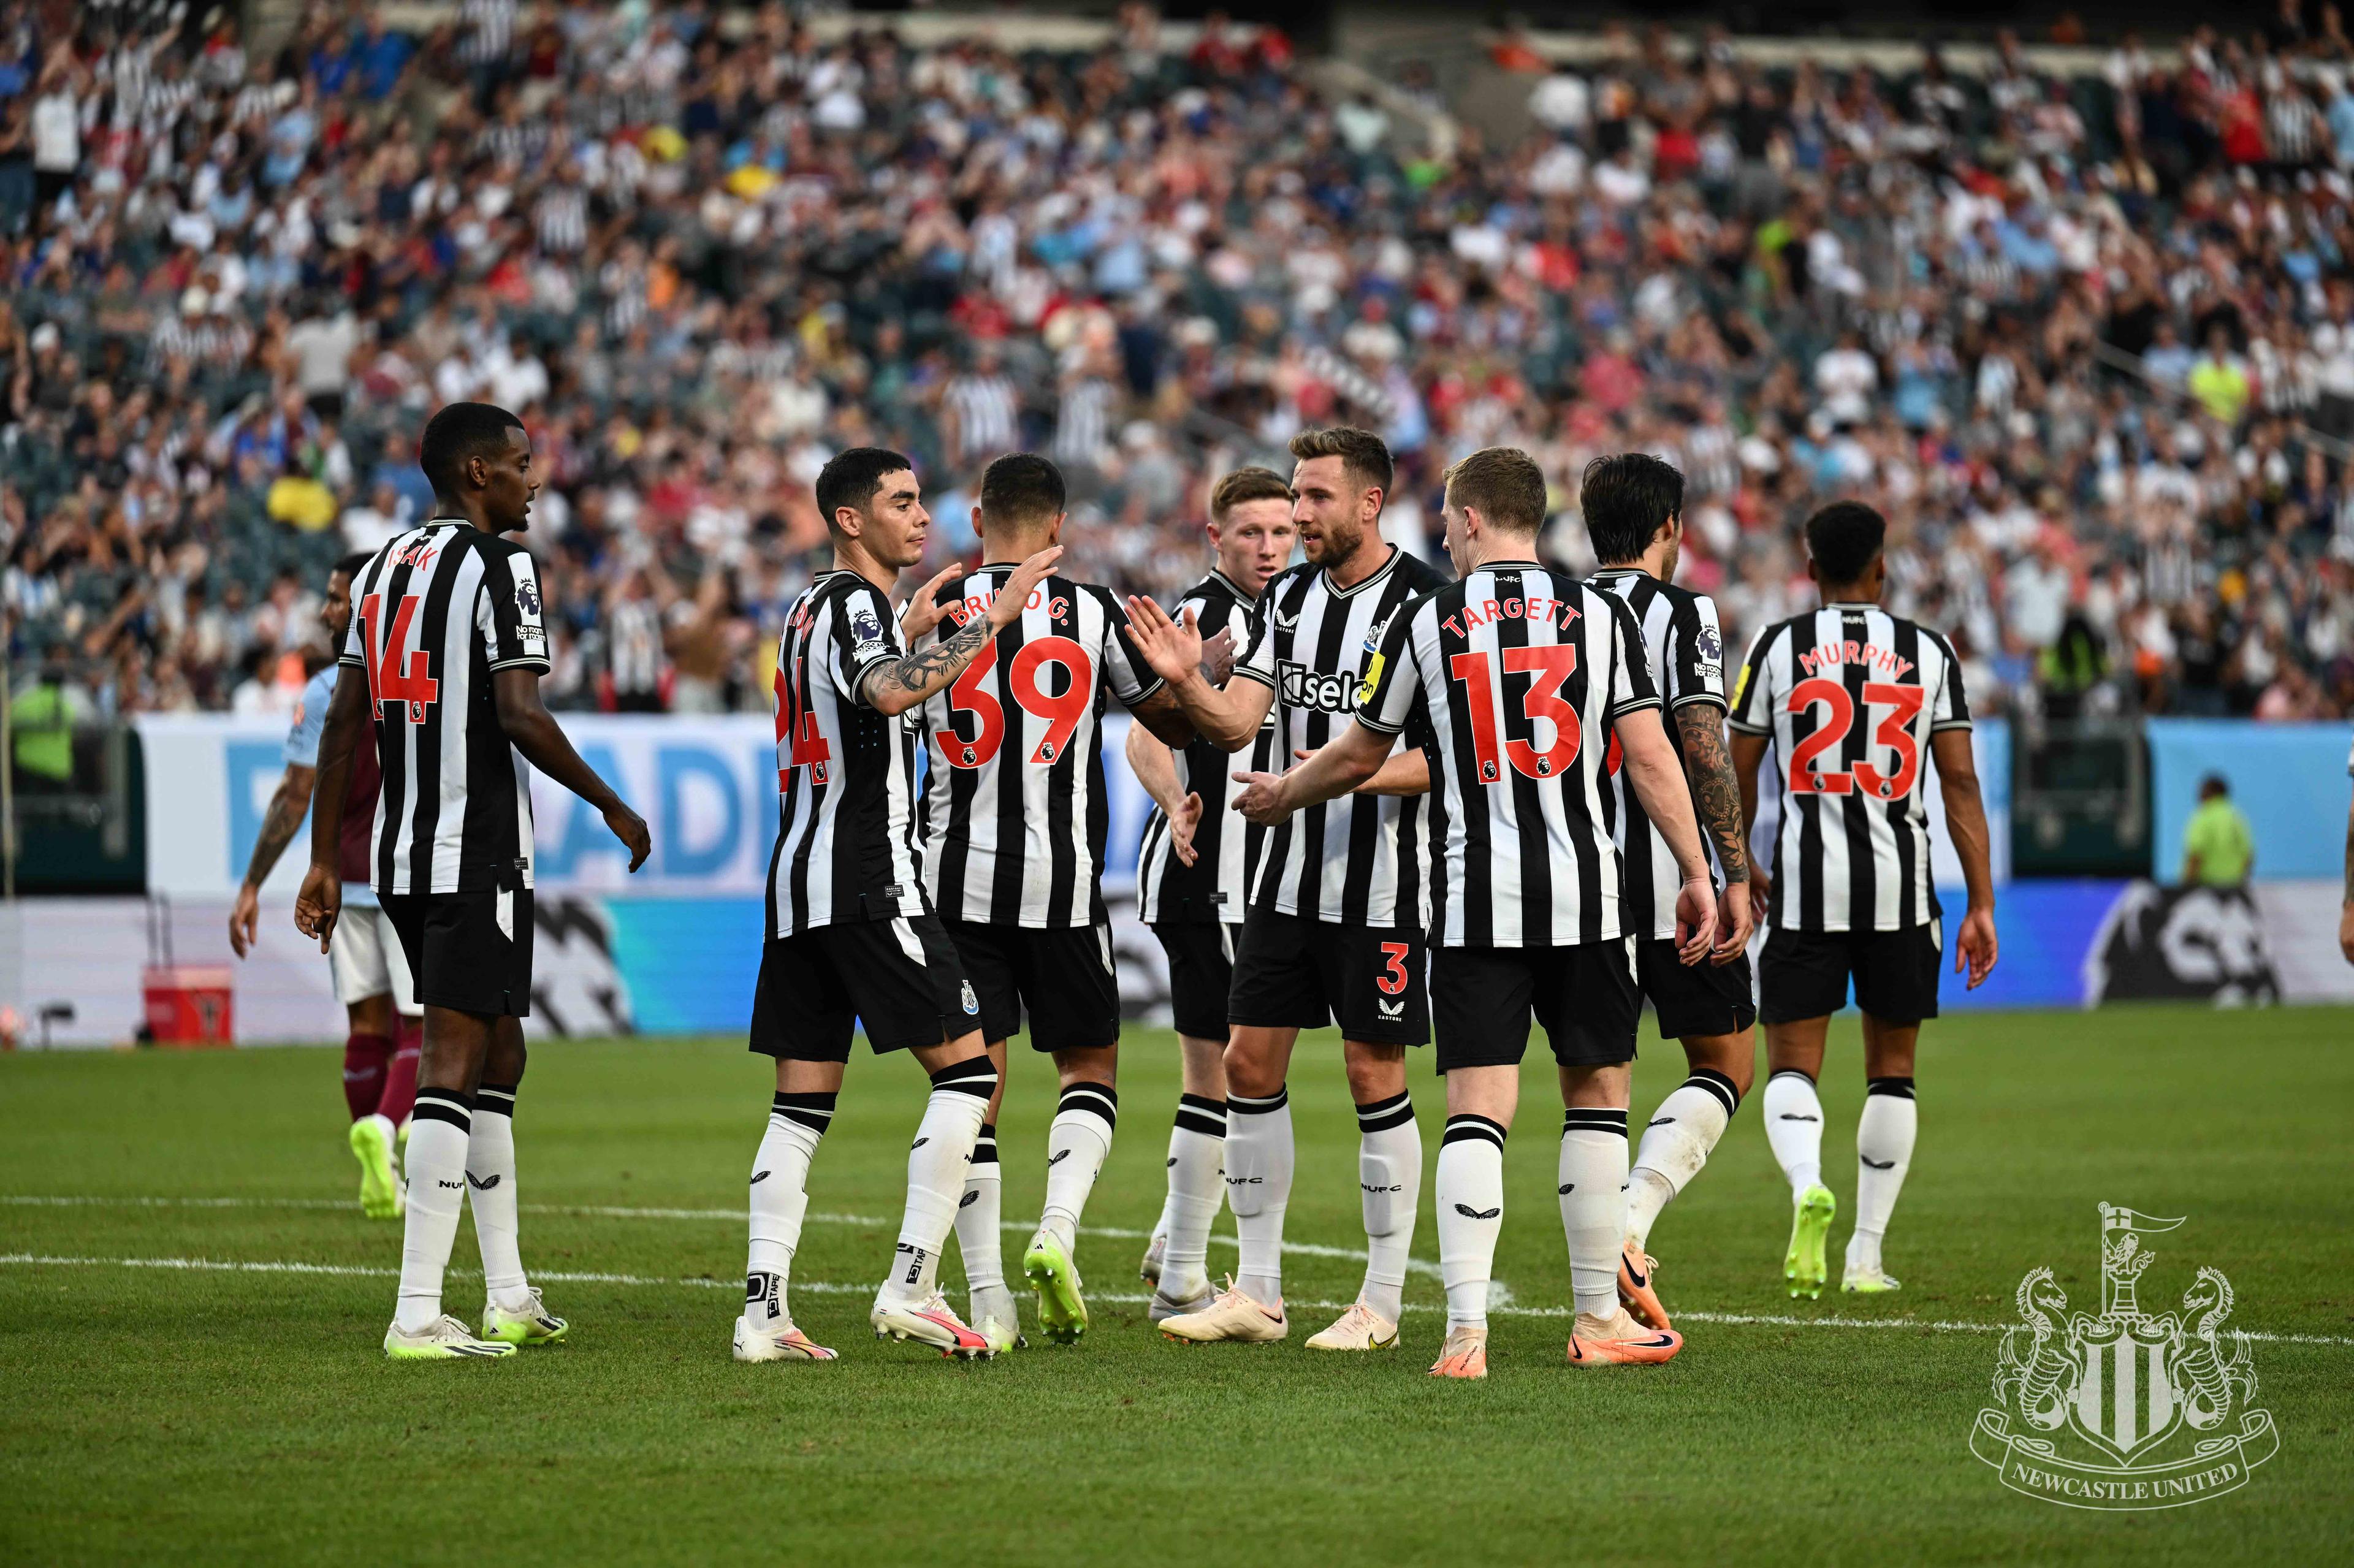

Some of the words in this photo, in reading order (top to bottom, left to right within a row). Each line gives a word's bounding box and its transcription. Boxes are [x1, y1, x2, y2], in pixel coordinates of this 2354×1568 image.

[387, 545, 438, 572] ISAK
[948, 588, 1042, 628] BRUO
[1441, 597, 1582, 639] TARGETT
[528, 626, 543, 635] room
[359, 593, 438, 725] 14
[1694, 663, 1707, 671] No
[1798, 639, 1914, 681] MURPHY
[931, 636, 1092, 769] 39
[1450, 643, 1582, 785] 13
[1786, 678, 1924, 802] 23
[1376, 942, 1409, 995] 3
[1361, 1182, 1402, 1193] NUFC
